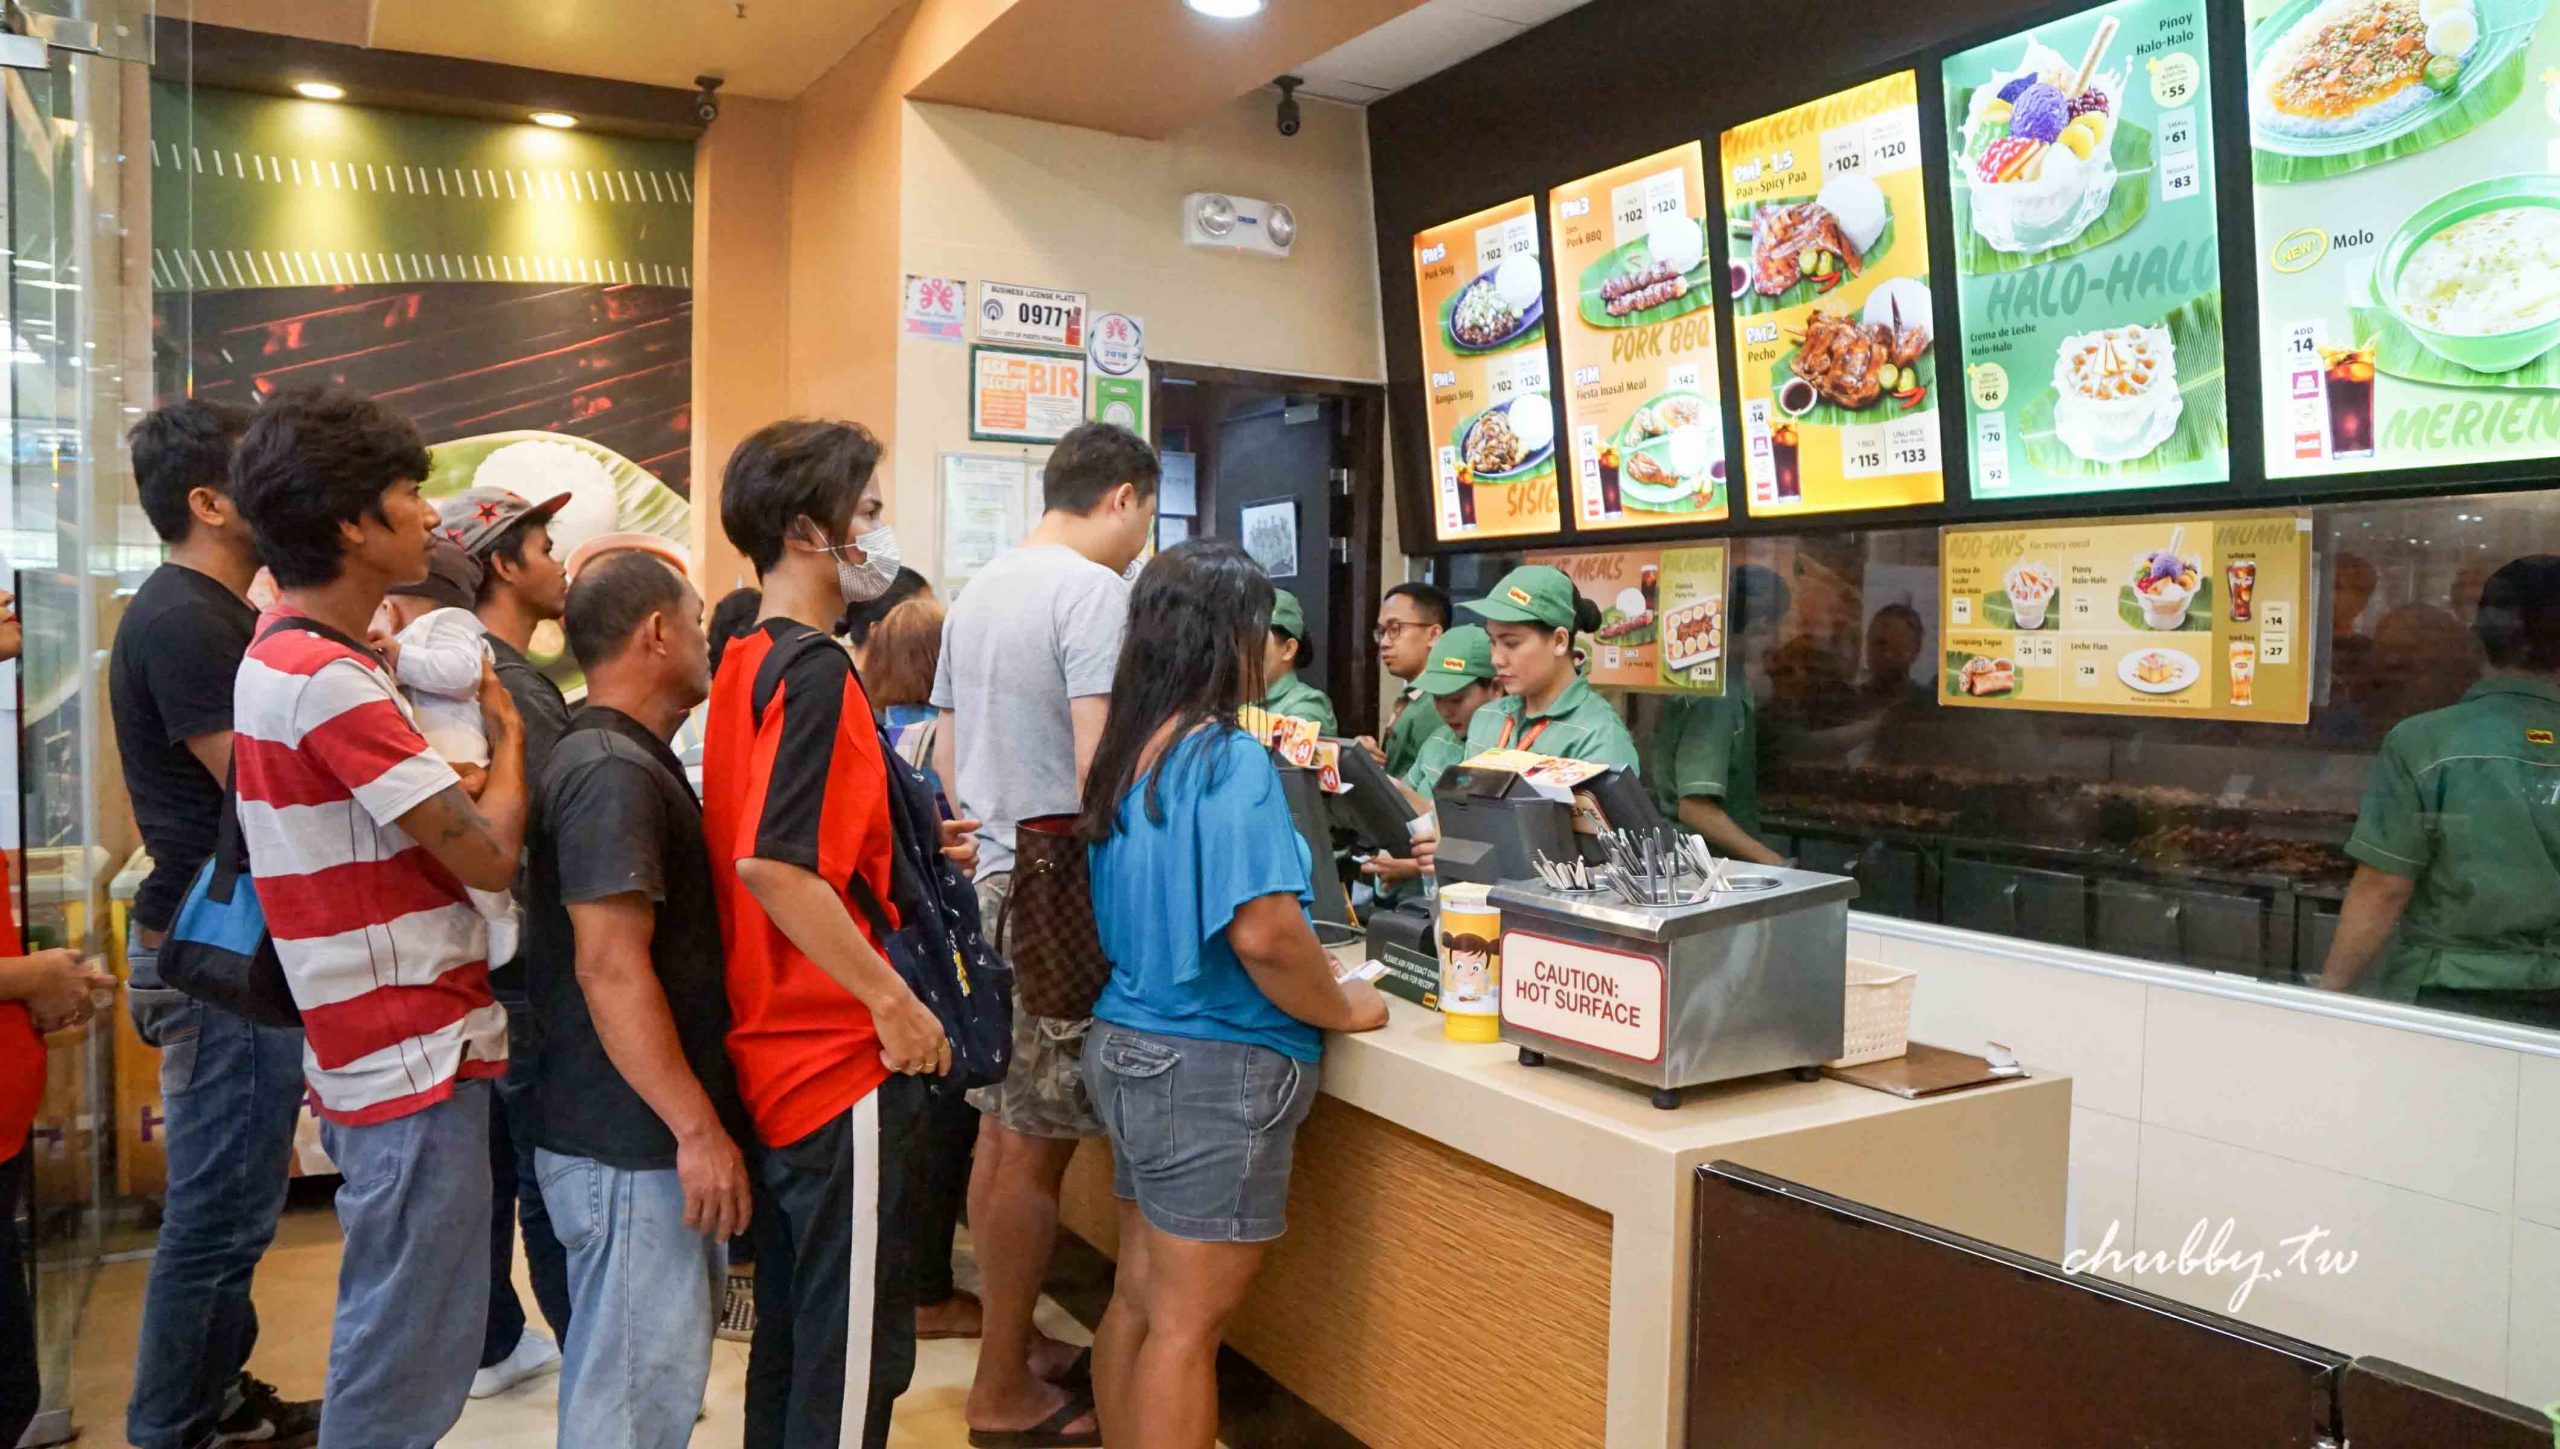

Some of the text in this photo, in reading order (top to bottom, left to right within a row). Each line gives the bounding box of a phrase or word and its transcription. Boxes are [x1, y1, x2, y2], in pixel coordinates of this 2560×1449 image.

[2159, 13, 2194, 31] Pinoy
[2136, 30, 2194, 56] Halo-Halo
[1786, 170, 1808, 186] Paa
[2332, 228, 2375, 250] Molo
[991, 285, 1076, 303] BUSINESS LICENSE PLATE
[1611, 317, 1711, 363] PORK BBQ
[1746, 320, 1778, 345] PM2
[1998, 327, 2010, 338] de
[2011, 322, 2038, 335] Leche
[2293, 326, 2314, 336] ADD
[1747, 347, 1777, 363] Pecho
[1027, 363, 1079, 398] BIR
[1600, 382, 1625, 397] Inasal
[1626, 378, 1648, 392] Meal
[1572, 555, 1625, 582] MEALS
[1534, 960, 1619, 999] CAUTION:
[1516, 979, 1642, 1029] HOT SURFACE
